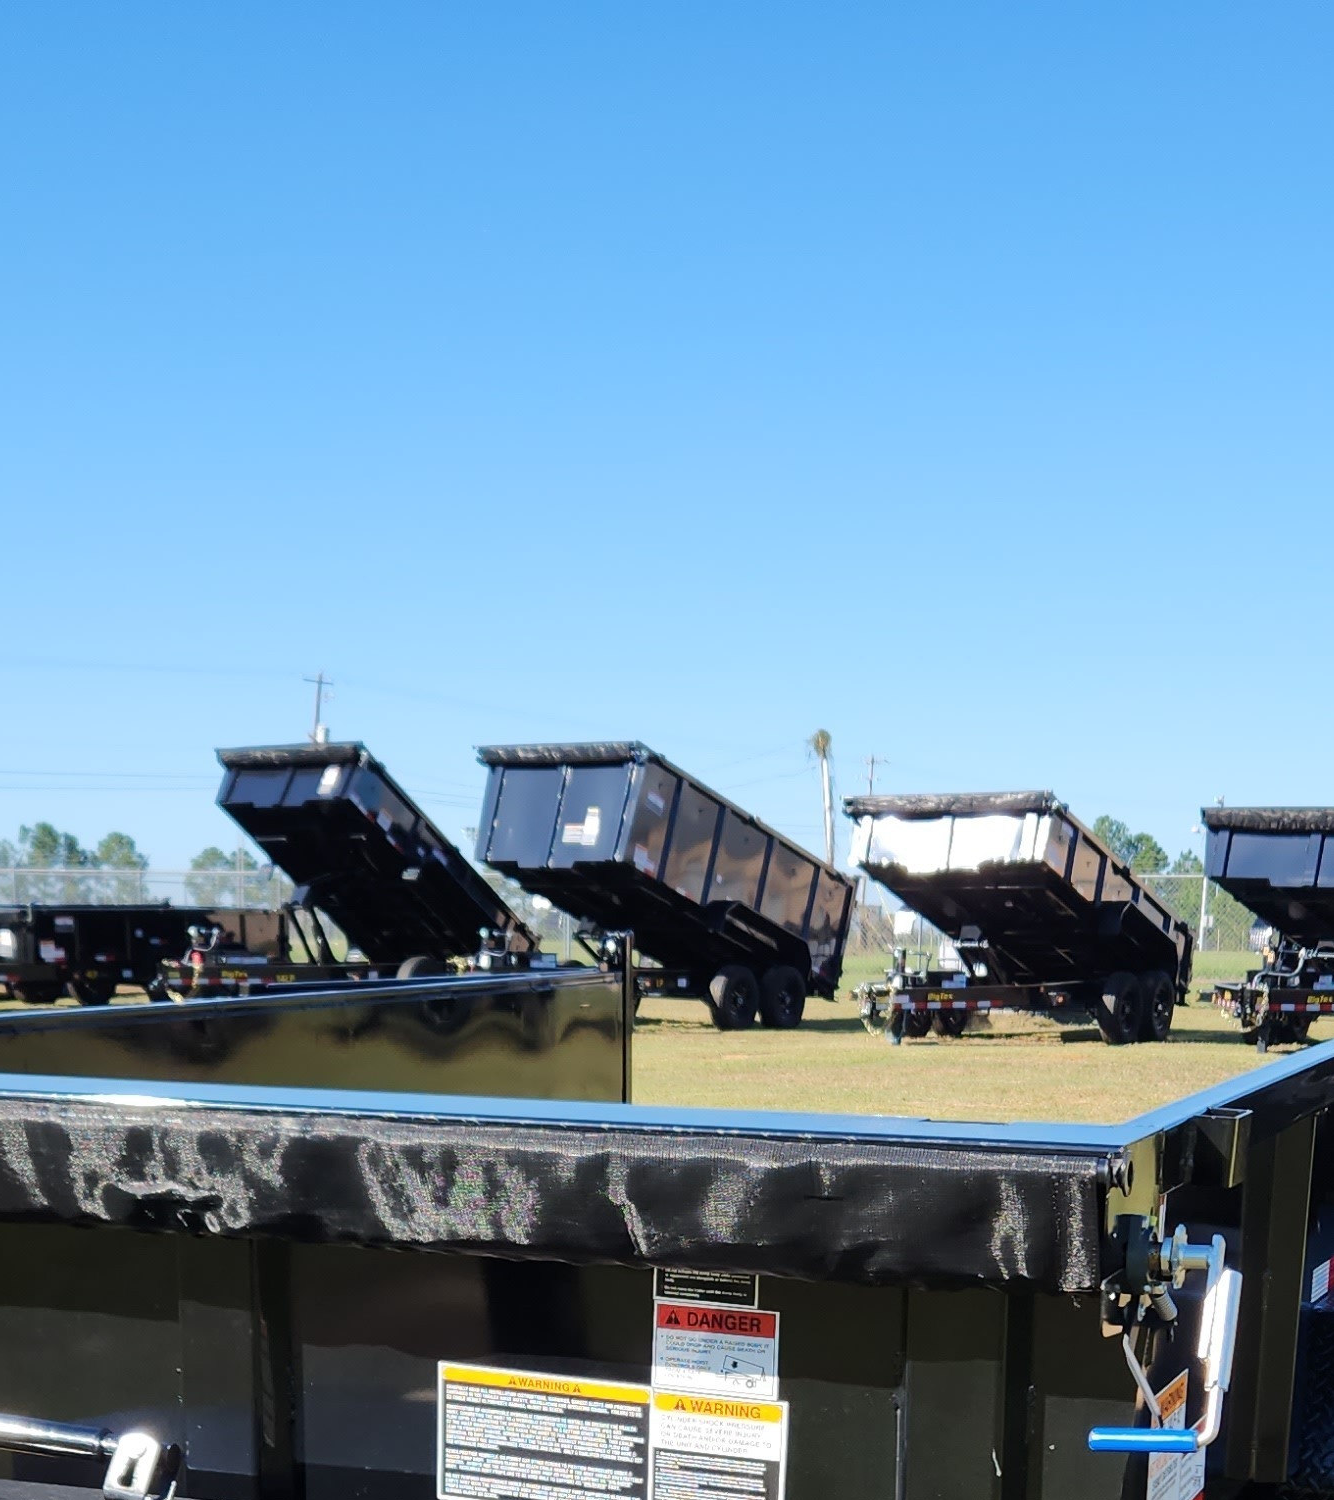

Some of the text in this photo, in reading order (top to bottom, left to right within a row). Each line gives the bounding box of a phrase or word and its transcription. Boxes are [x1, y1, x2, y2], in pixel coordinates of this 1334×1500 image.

[687, 1311, 762, 1332] DANGER
[518, 1377, 570, 1393] WARNING
[690, 1399, 762, 1419] WARNING
